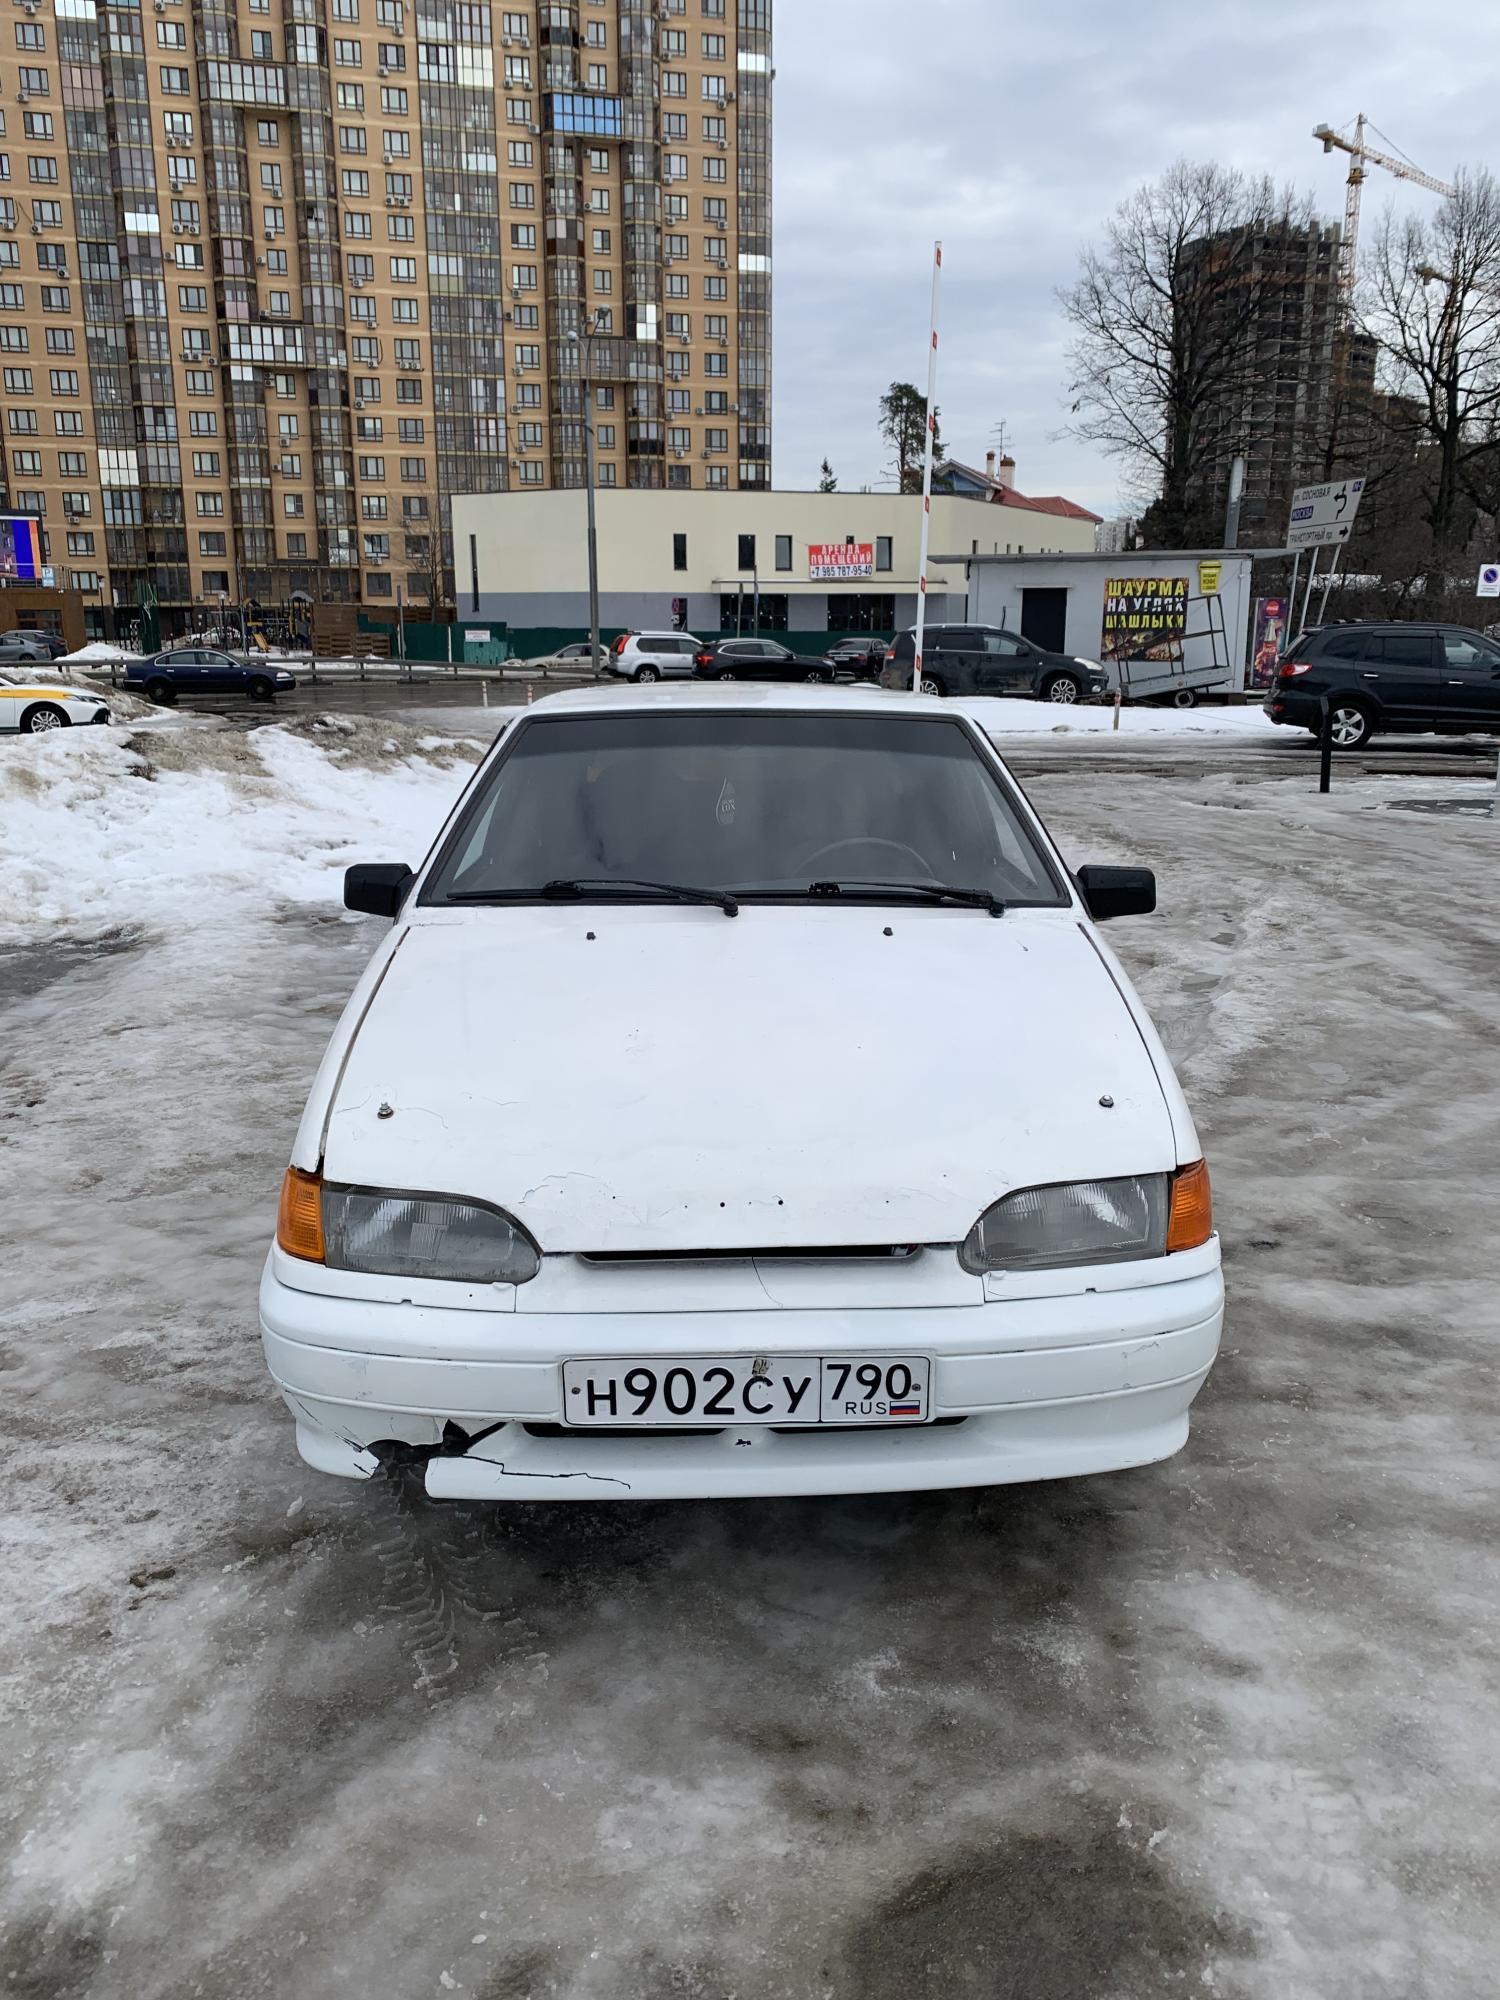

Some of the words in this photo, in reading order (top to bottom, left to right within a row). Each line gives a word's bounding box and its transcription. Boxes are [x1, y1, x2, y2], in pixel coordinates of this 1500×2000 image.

[1302, 487, 1331, 501] СОСНОВАЯ
[1293, 507, 1313, 520] МОСКВА
[821, 545, 860, 555] АРЕНДА
[811, 552, 872, 565] ПОМЕЩЕНИЯ
[811, 567, 820, 577] +7
[1108, 581, 1184, 596] ШАУРМА
[1107, 598, 1127, 612] НА
[1133, 597, 1184, 612] УГЛЯХ
[1105, 614, 1184, 629] ШАШЛЫКИ
[586, 1367, 812, 1415] Н902СУ
[826, 1363, 911, 1400] 790
[845, 1401, 887, 1415] RUS
